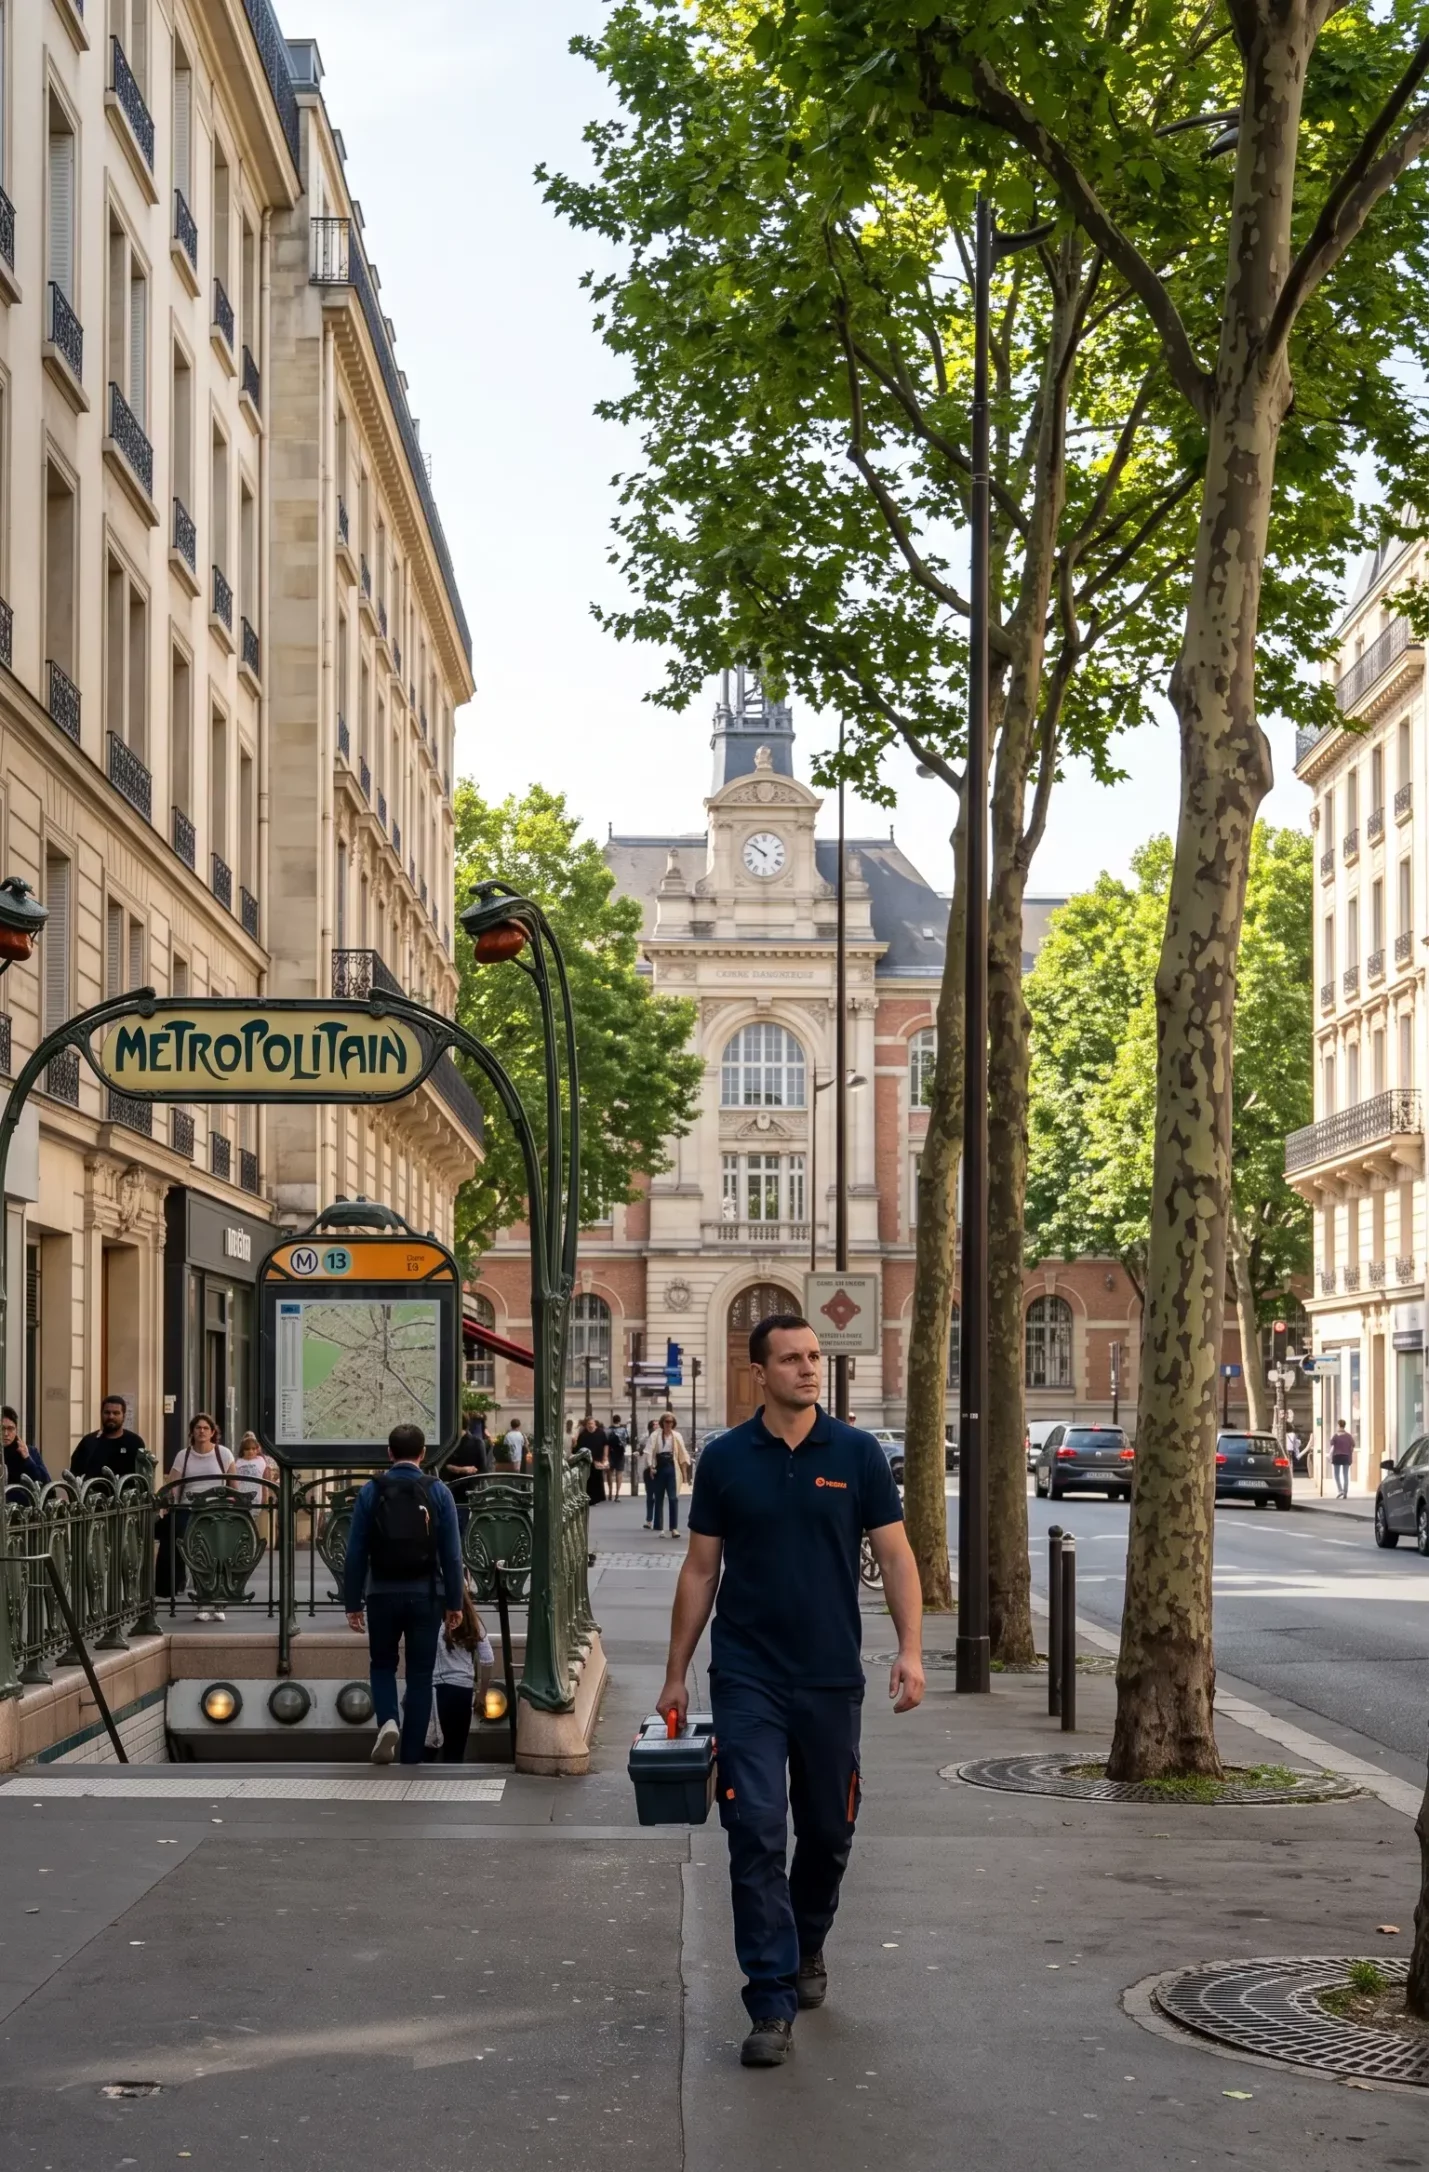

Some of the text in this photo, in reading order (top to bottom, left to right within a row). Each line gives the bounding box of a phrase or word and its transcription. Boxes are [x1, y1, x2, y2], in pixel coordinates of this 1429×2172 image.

[115, 1019, 408, 1080] METROPOLITAIN
[296, 1253, 346, 1269] M 13
